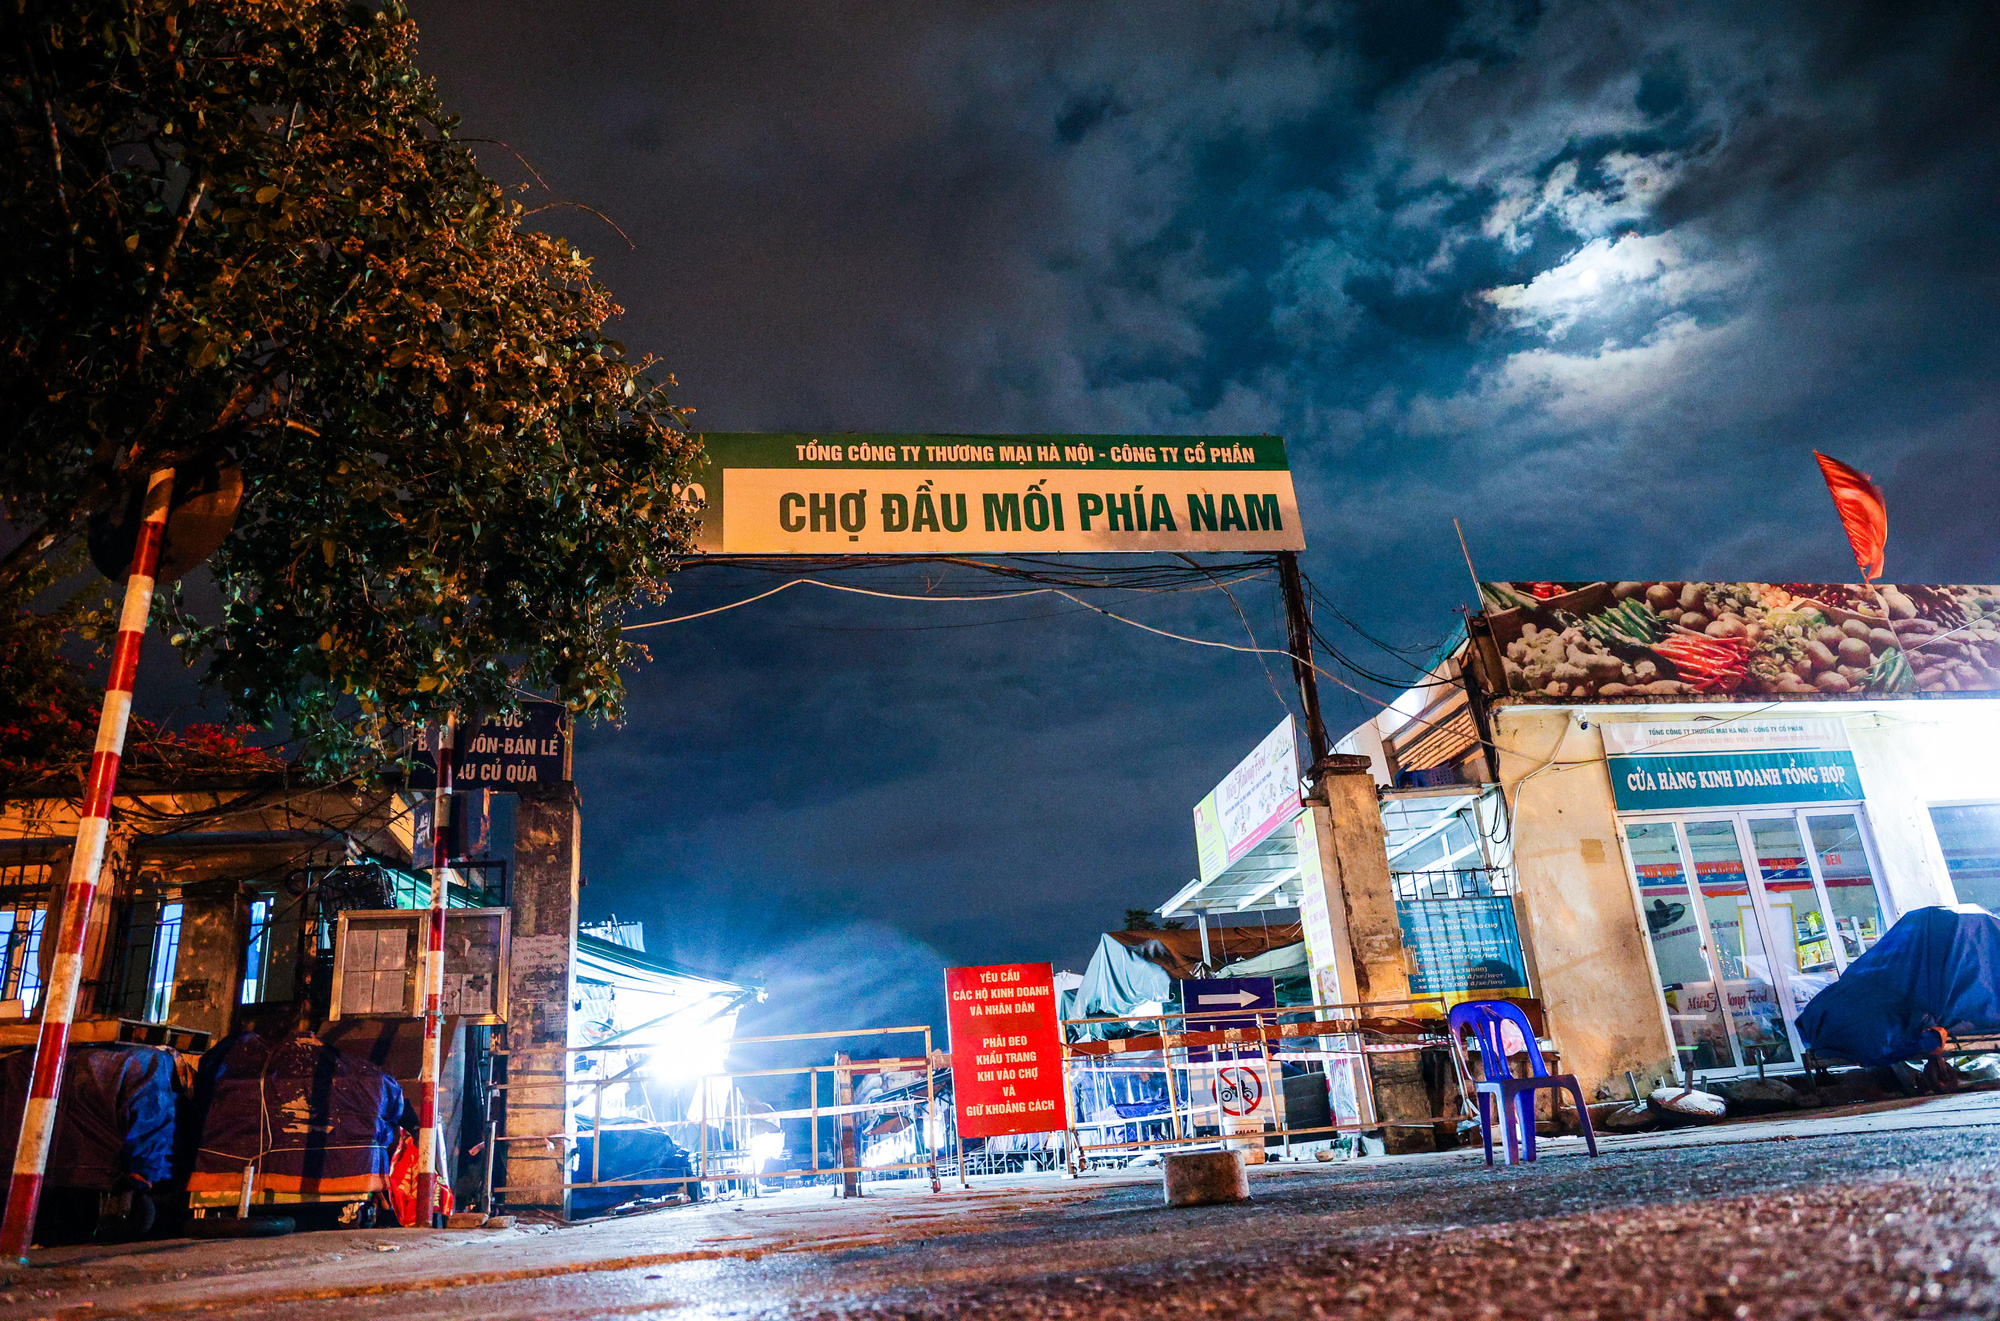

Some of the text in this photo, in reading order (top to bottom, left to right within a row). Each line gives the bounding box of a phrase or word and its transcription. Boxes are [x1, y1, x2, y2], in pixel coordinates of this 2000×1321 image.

[795, 438, 843, 462] TỔNG
[847, 442, 897, 462] CÔNG
[900, 445, 921, 462] TY
[925, 444, 995, 462] THƯƠNG
[999, 445, 1033, 466] MẠI
[1037, 442, 1061, 462] HÀ
[1064, 442, 1095, 466] NỘI
[1110, 443, 1158, 463] CÔNG
[1159, 446, 1179, 463] TY
[1184, 441, 1207, 464] CỔ
[1210, 442, 1256, 463] PHẦN
[779, 478, 1283, 542] CHỢ ĐẦU MỐI PHÍA NAM
[541, 733, 558, 756] LẺ
[457, 763, 477, 781] AU
[480, 758, 501, 781] CỦ
[1627, 758, 1846, 792] CỬA HÀNG KINH DOANH TỔNG HỢP
[980, 971, 998, 984] YÊU
[953, 986, 1050, 1002] CÁC HỘ KINH DOANH
[1746, 988, 1768, 1004] Food
[969, 1001, 1036, 1017] VÀ NHÂN DÂN
[982, 1034, 1028, 1049] PHẢI ĐEO
[976, 1050, 1038, 1066] KHẨU TRANG
[977, 1067, 1039, 1082] KHI VÀO CHỢ
[1002, 1084, 1016, 1097] VÀ
[966, 1098, 1056, 1117] GIỮ KHOẢNG CÁCH
